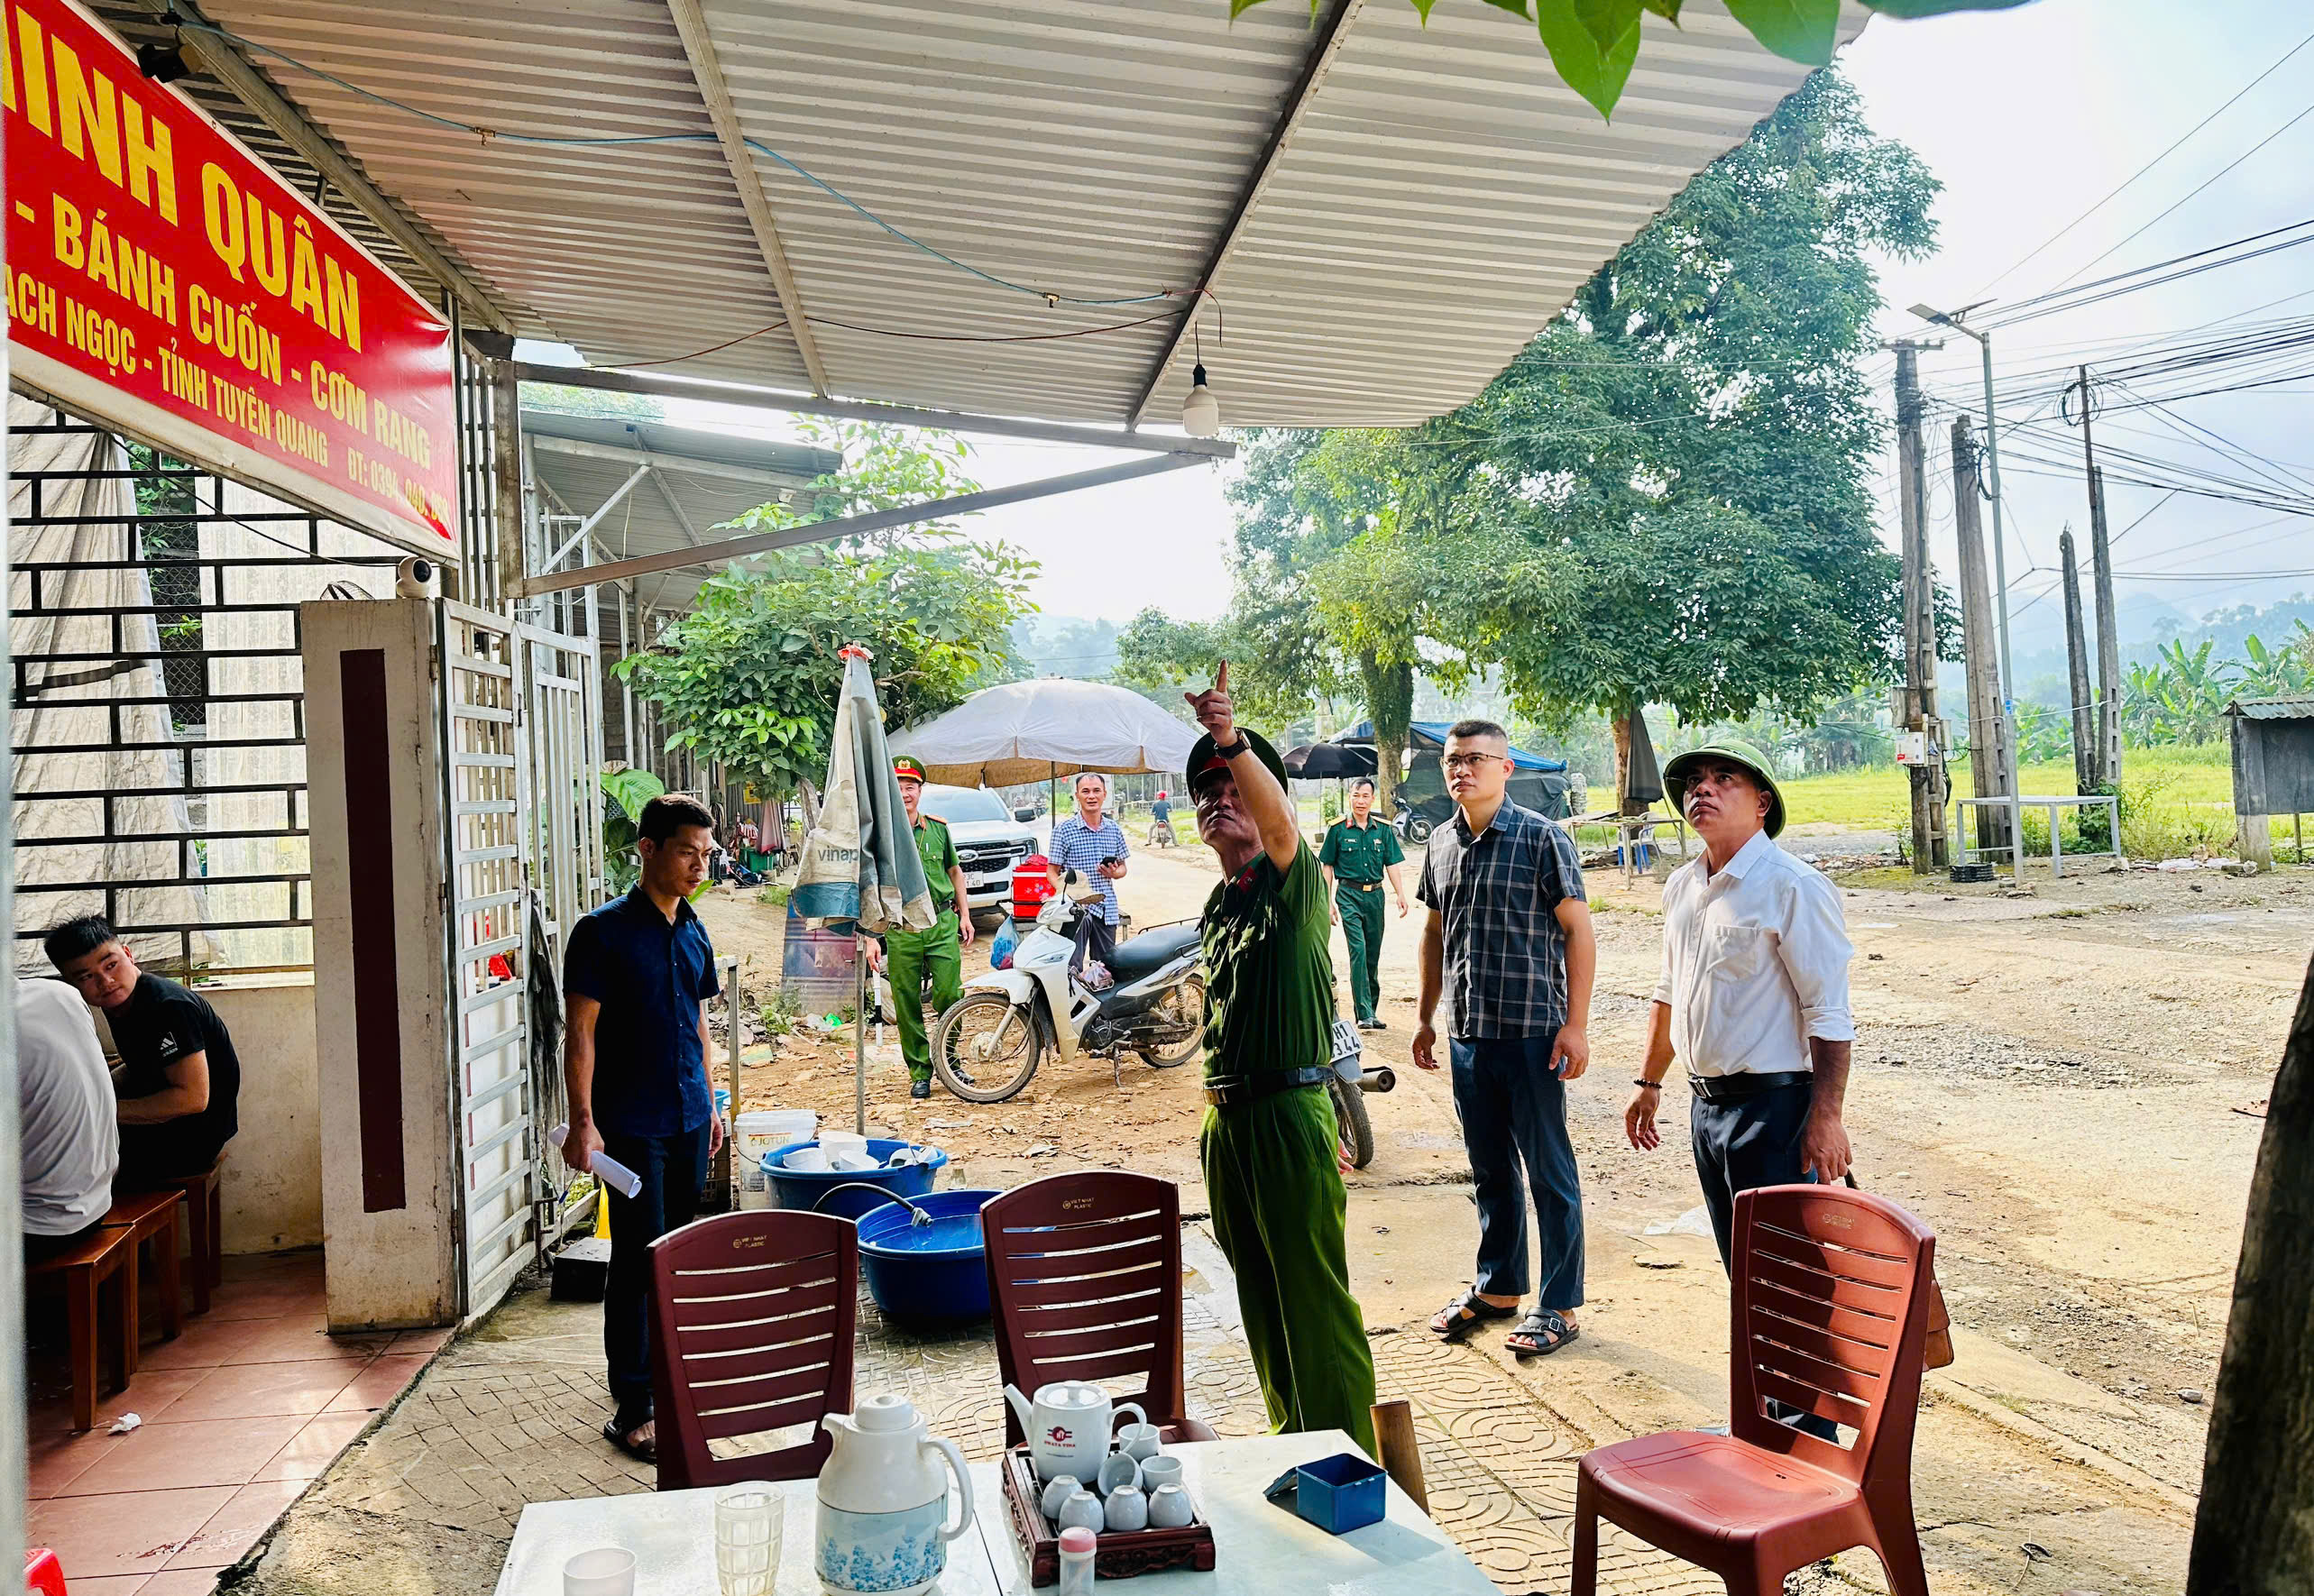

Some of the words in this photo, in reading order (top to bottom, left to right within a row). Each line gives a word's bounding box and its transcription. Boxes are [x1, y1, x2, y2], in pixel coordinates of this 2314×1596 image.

[52, 192, 177, 326] BÁNH
[188, 283, 281, 387] CUỐN
[310, 361, 368, 435] CƠM
[373, 398, 431, 470] RANG
[201, 161, 362, 353] QUÂN
[66, 296, 135, 377] NGỌC
[158, 336, 208, 410] TỈNH
[212, 374, 271, 441] TUYÊN
[275, 409, 328, 467] QUANG
